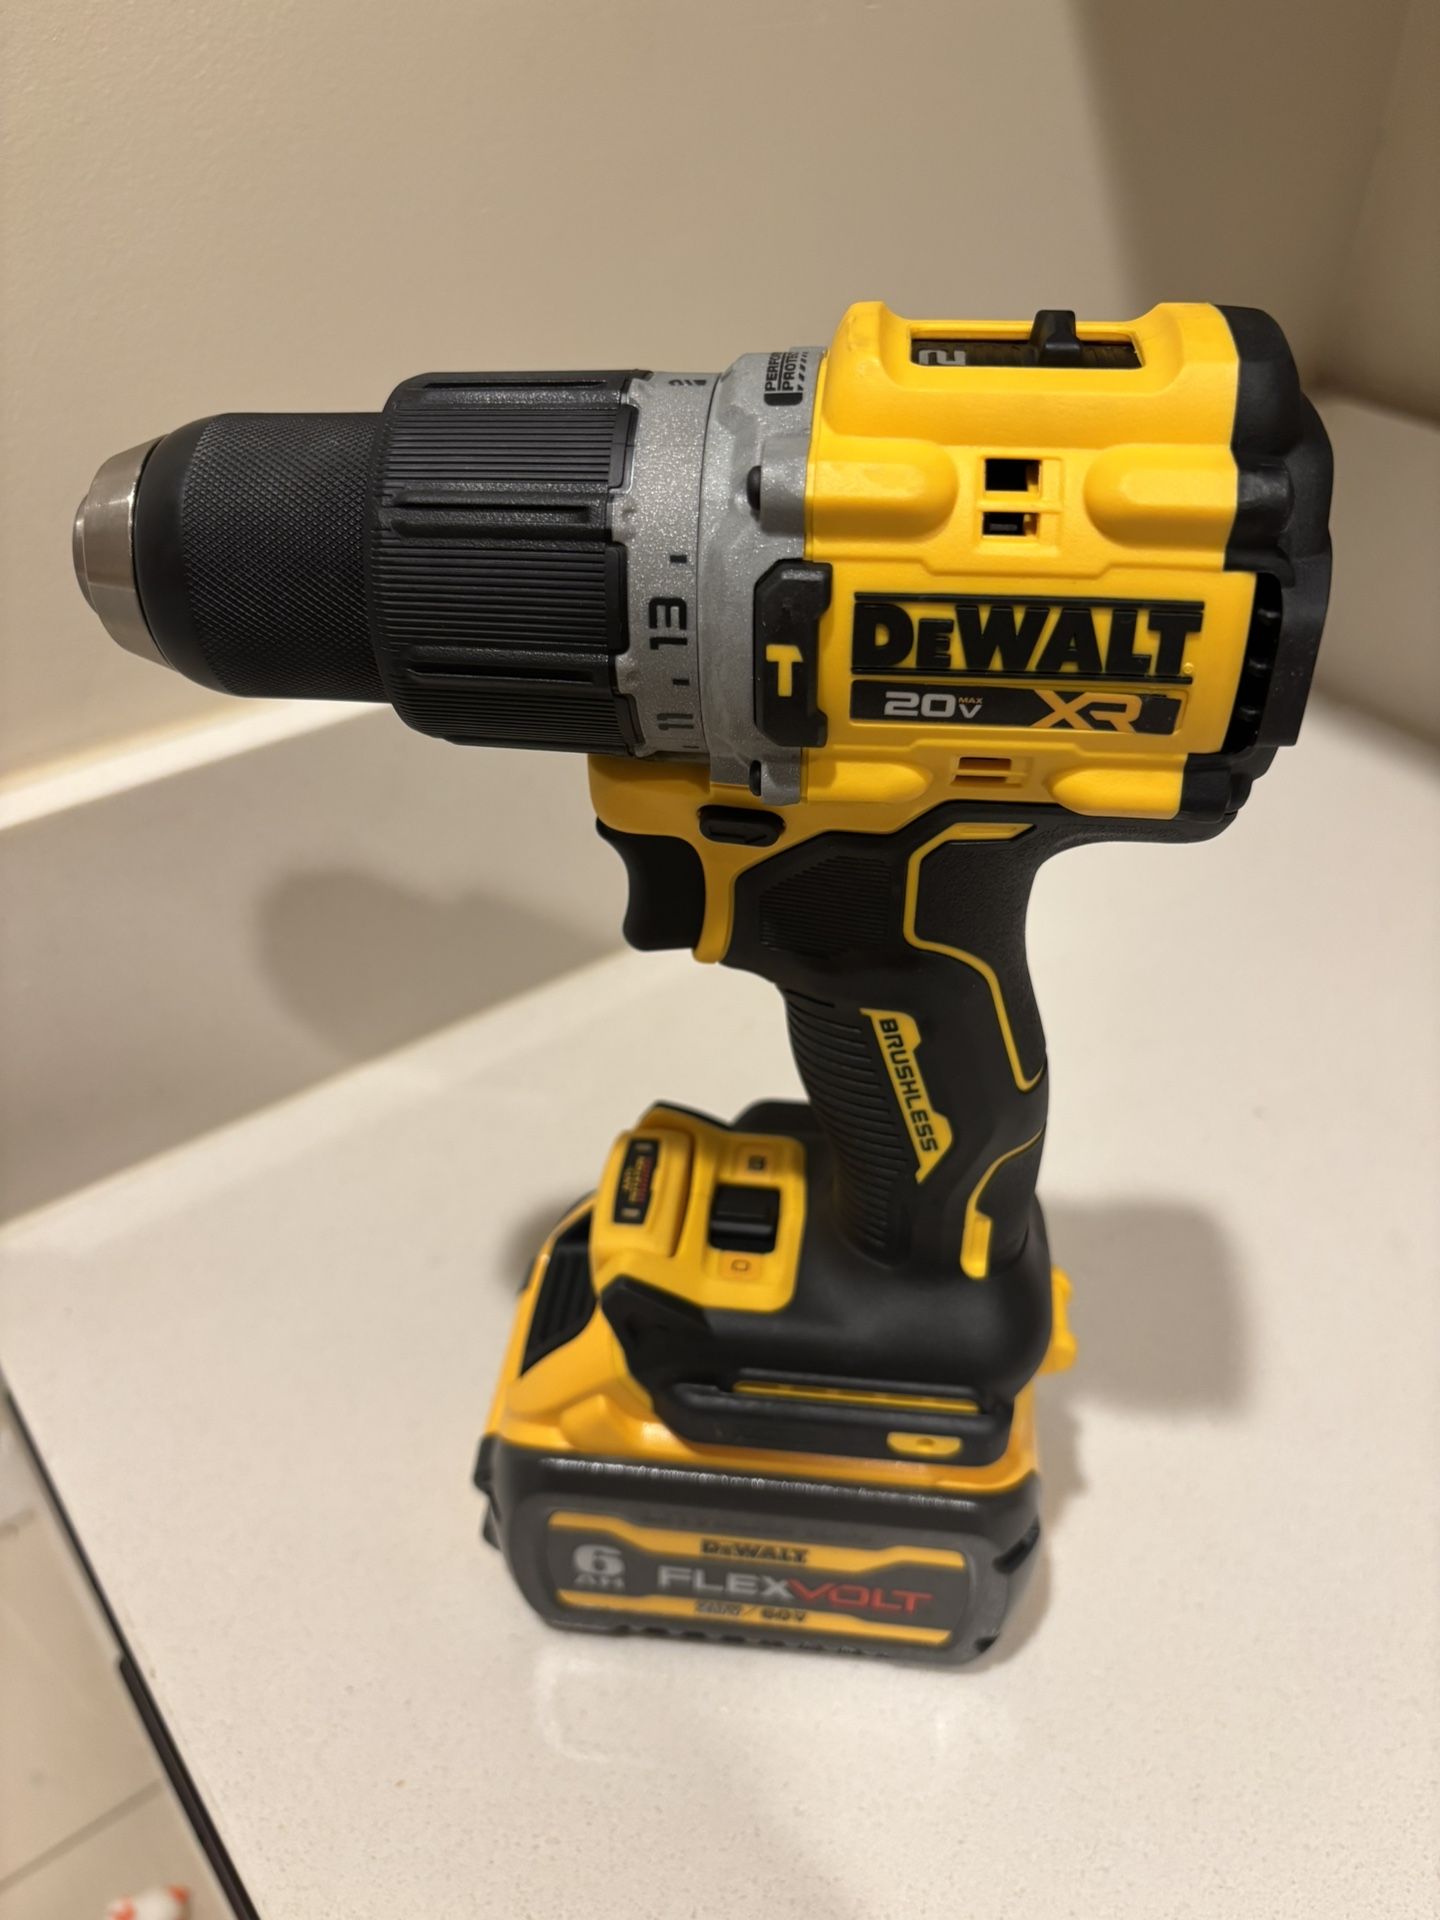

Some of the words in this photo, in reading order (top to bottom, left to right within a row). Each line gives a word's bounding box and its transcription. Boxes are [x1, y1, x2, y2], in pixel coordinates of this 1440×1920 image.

[649, 597, 688, 650] 13
[851, 602, 1203, 677] DEWALT
[657, 713, 694, 730] 11
[1029, 689, 1143, 733] XR
[879, 1018, 938, 1152] BRUSHLESS
[573, 1544, 625, 1575] 6
[701, 1537, 809, 1564] DEWALT
[657, 1564, 934, 1616] FLEXVOLT
